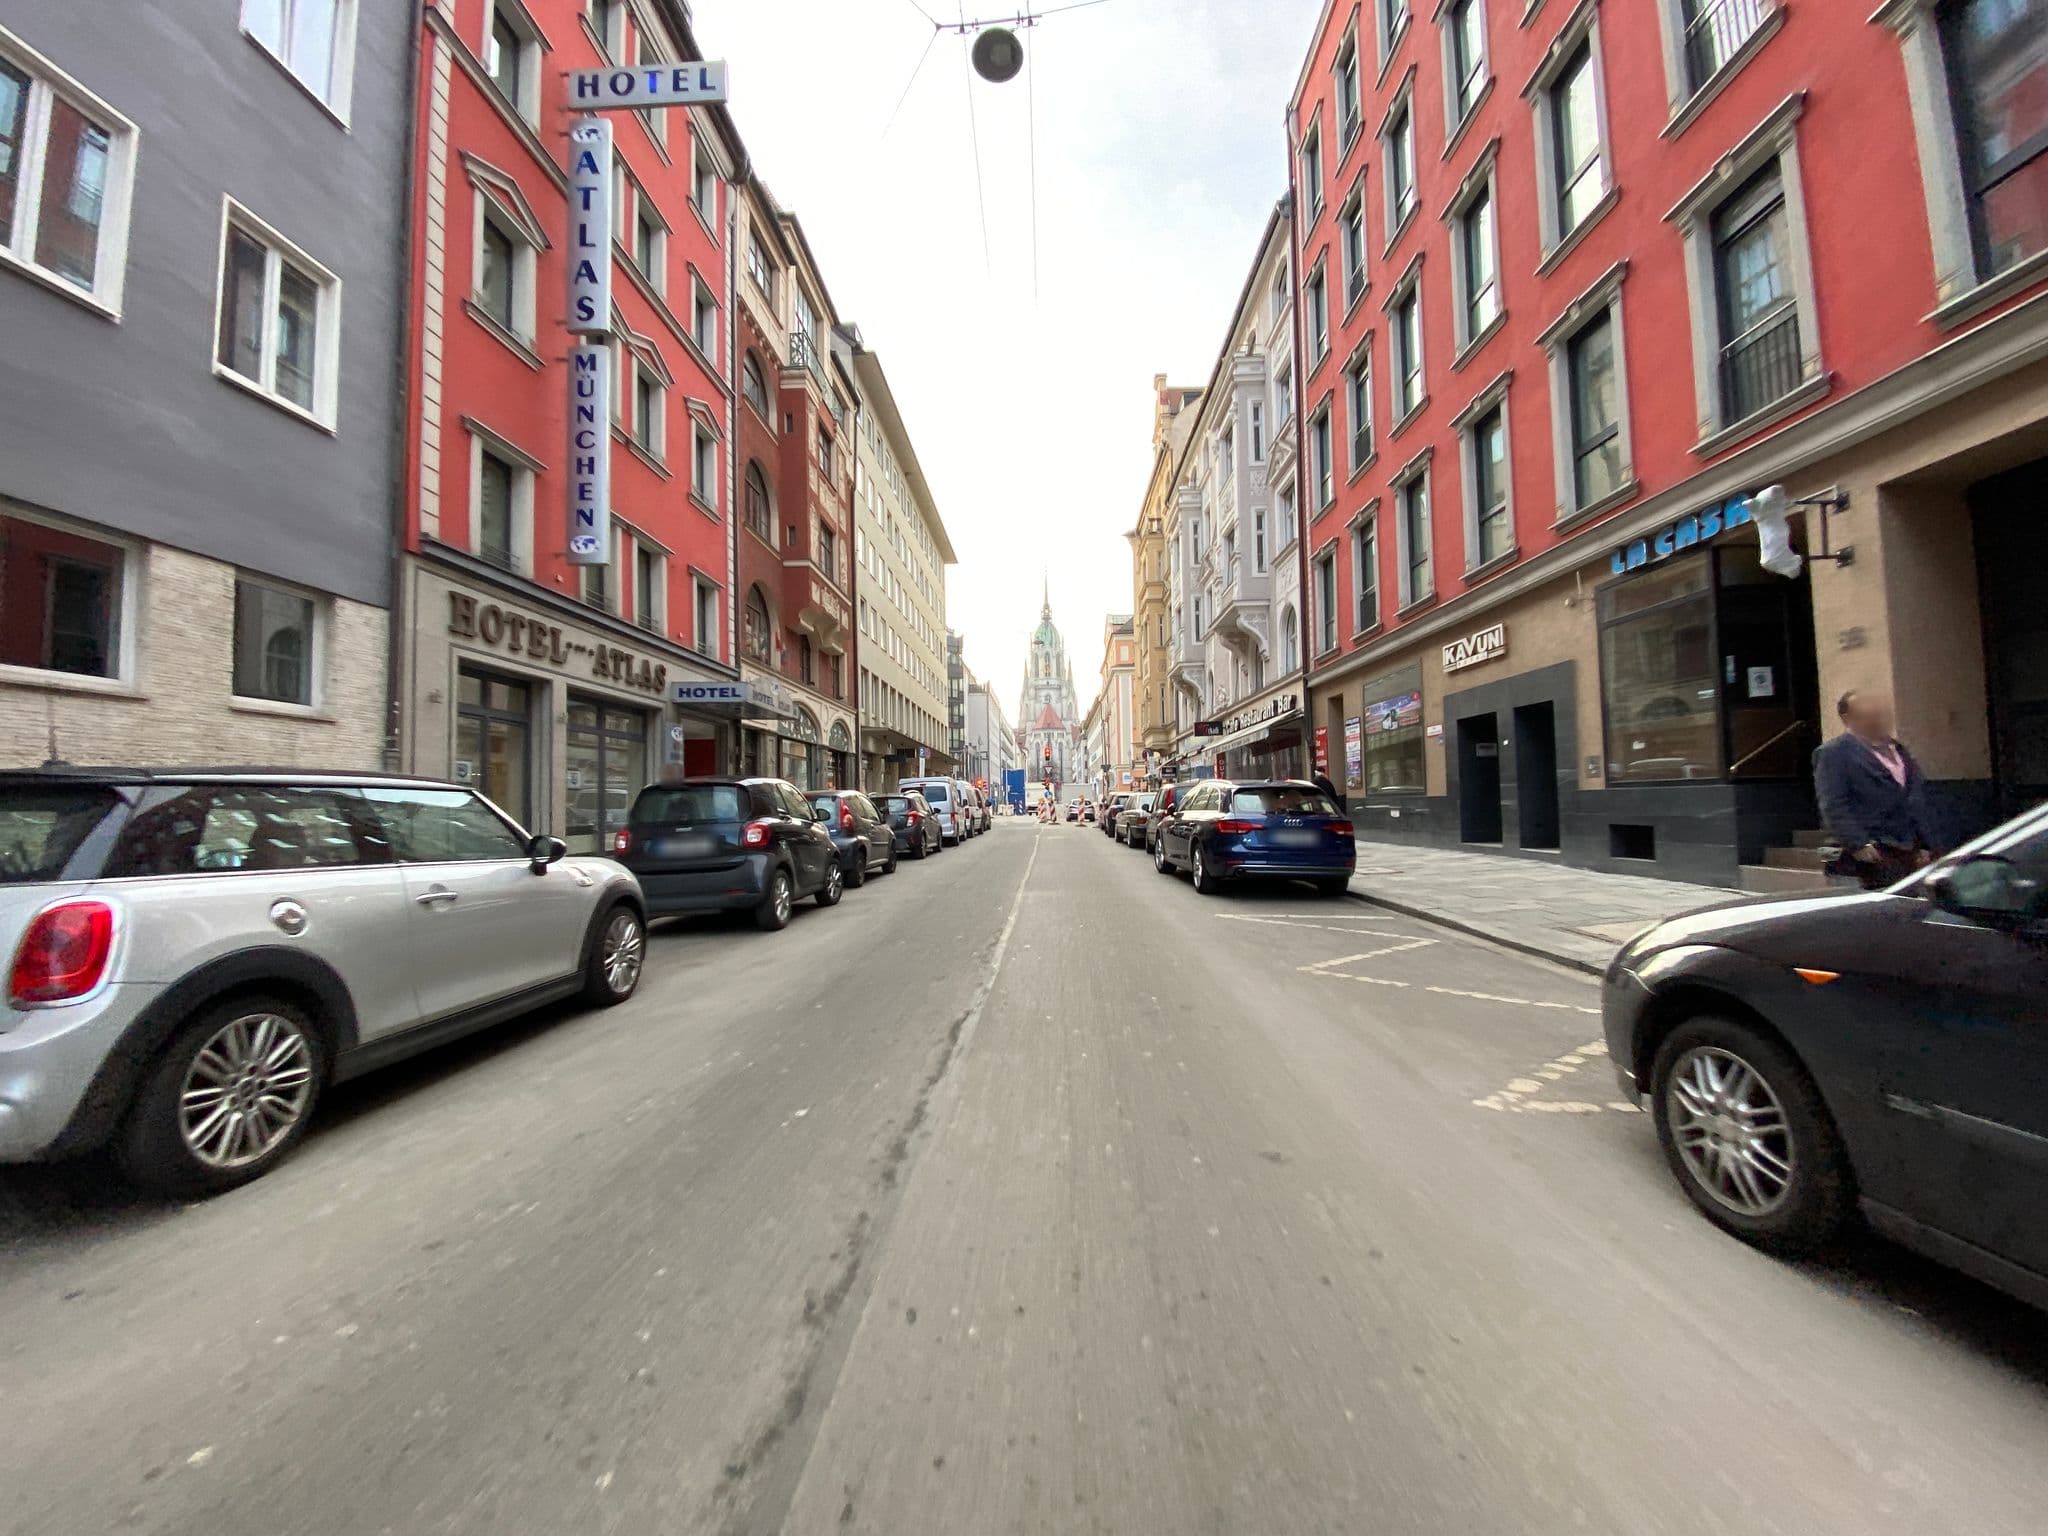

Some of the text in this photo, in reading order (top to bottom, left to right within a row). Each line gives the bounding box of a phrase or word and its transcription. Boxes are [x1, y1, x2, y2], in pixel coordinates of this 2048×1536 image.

[577, 67, 716, 98] HOTEL
[574, 150, 600, 322] ATLAS
[575, 353, 597, 528] MÜNCHEN
[1610, 491, 1751, 574] LA CASA
[448, 590, 667, 694] HOTEL ATLAS
[1445, 629, 1500, 666] KAVUN
[678, 687, 742, 698] HOTEL
[752, 690, 776, 708] HOTEL
[1277, 694, 1294, 713] Bar
